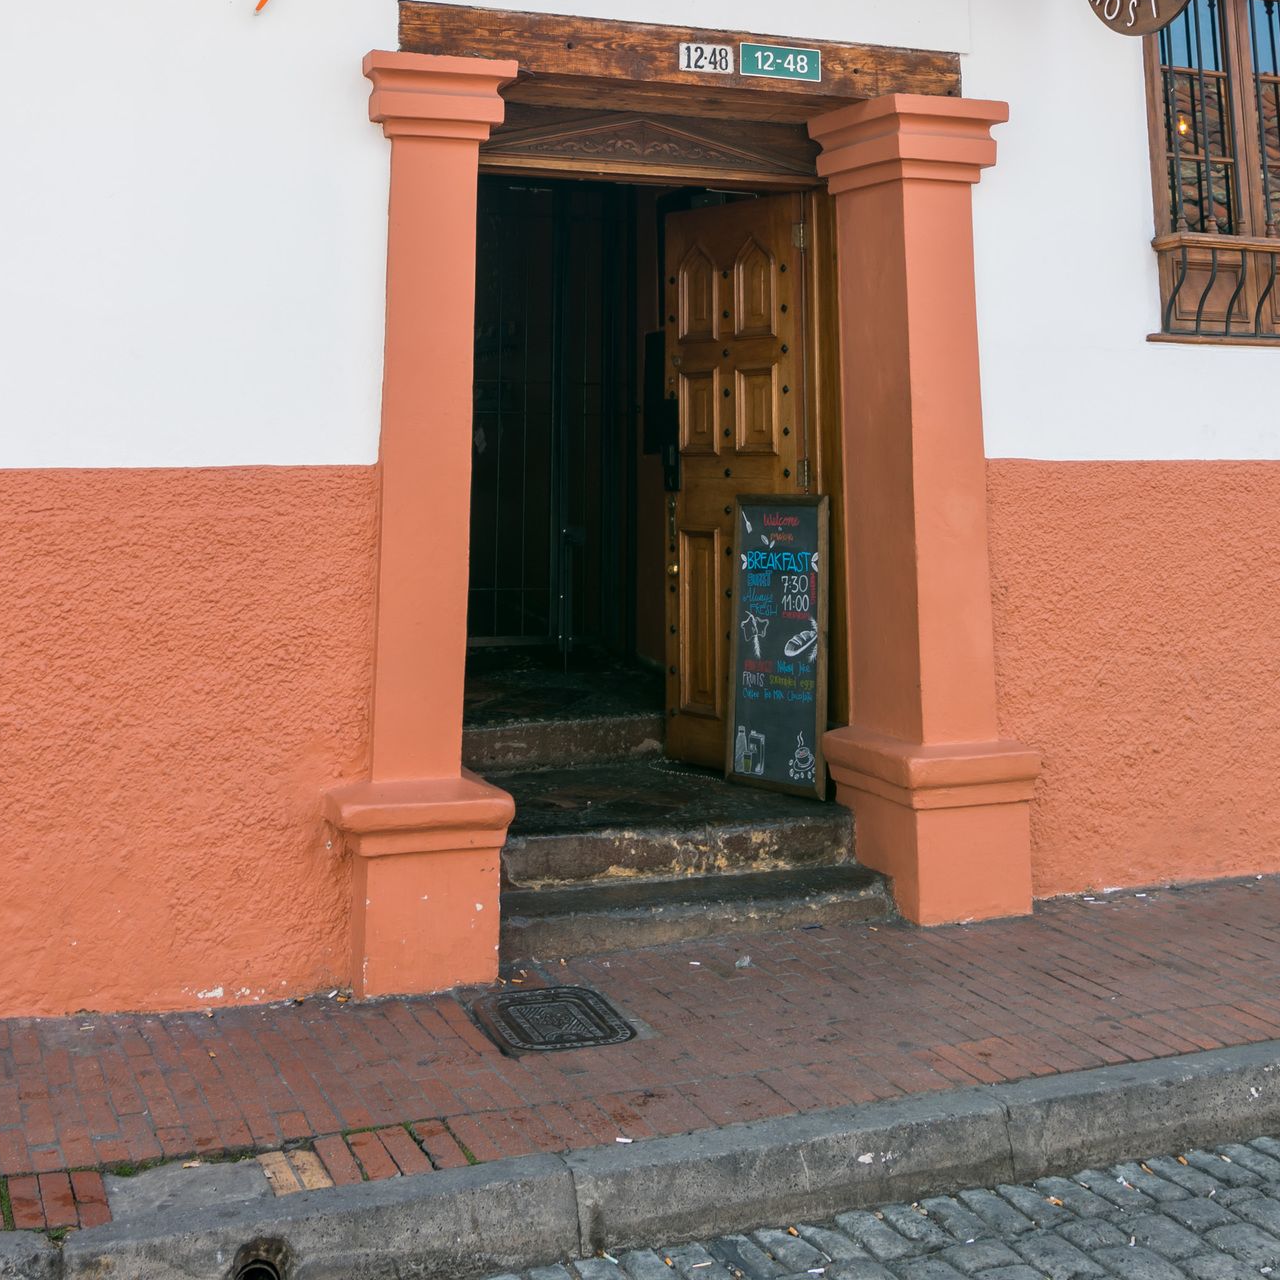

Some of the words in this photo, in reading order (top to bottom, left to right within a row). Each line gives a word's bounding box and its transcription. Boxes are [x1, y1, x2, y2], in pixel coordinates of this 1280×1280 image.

[754, 51, 809, 74] 12-48
[747, 550, 812, 572] BREAKFAST
[781, 574, 809, 594] 7:30
[781, 594, 810, 612] 11:00
